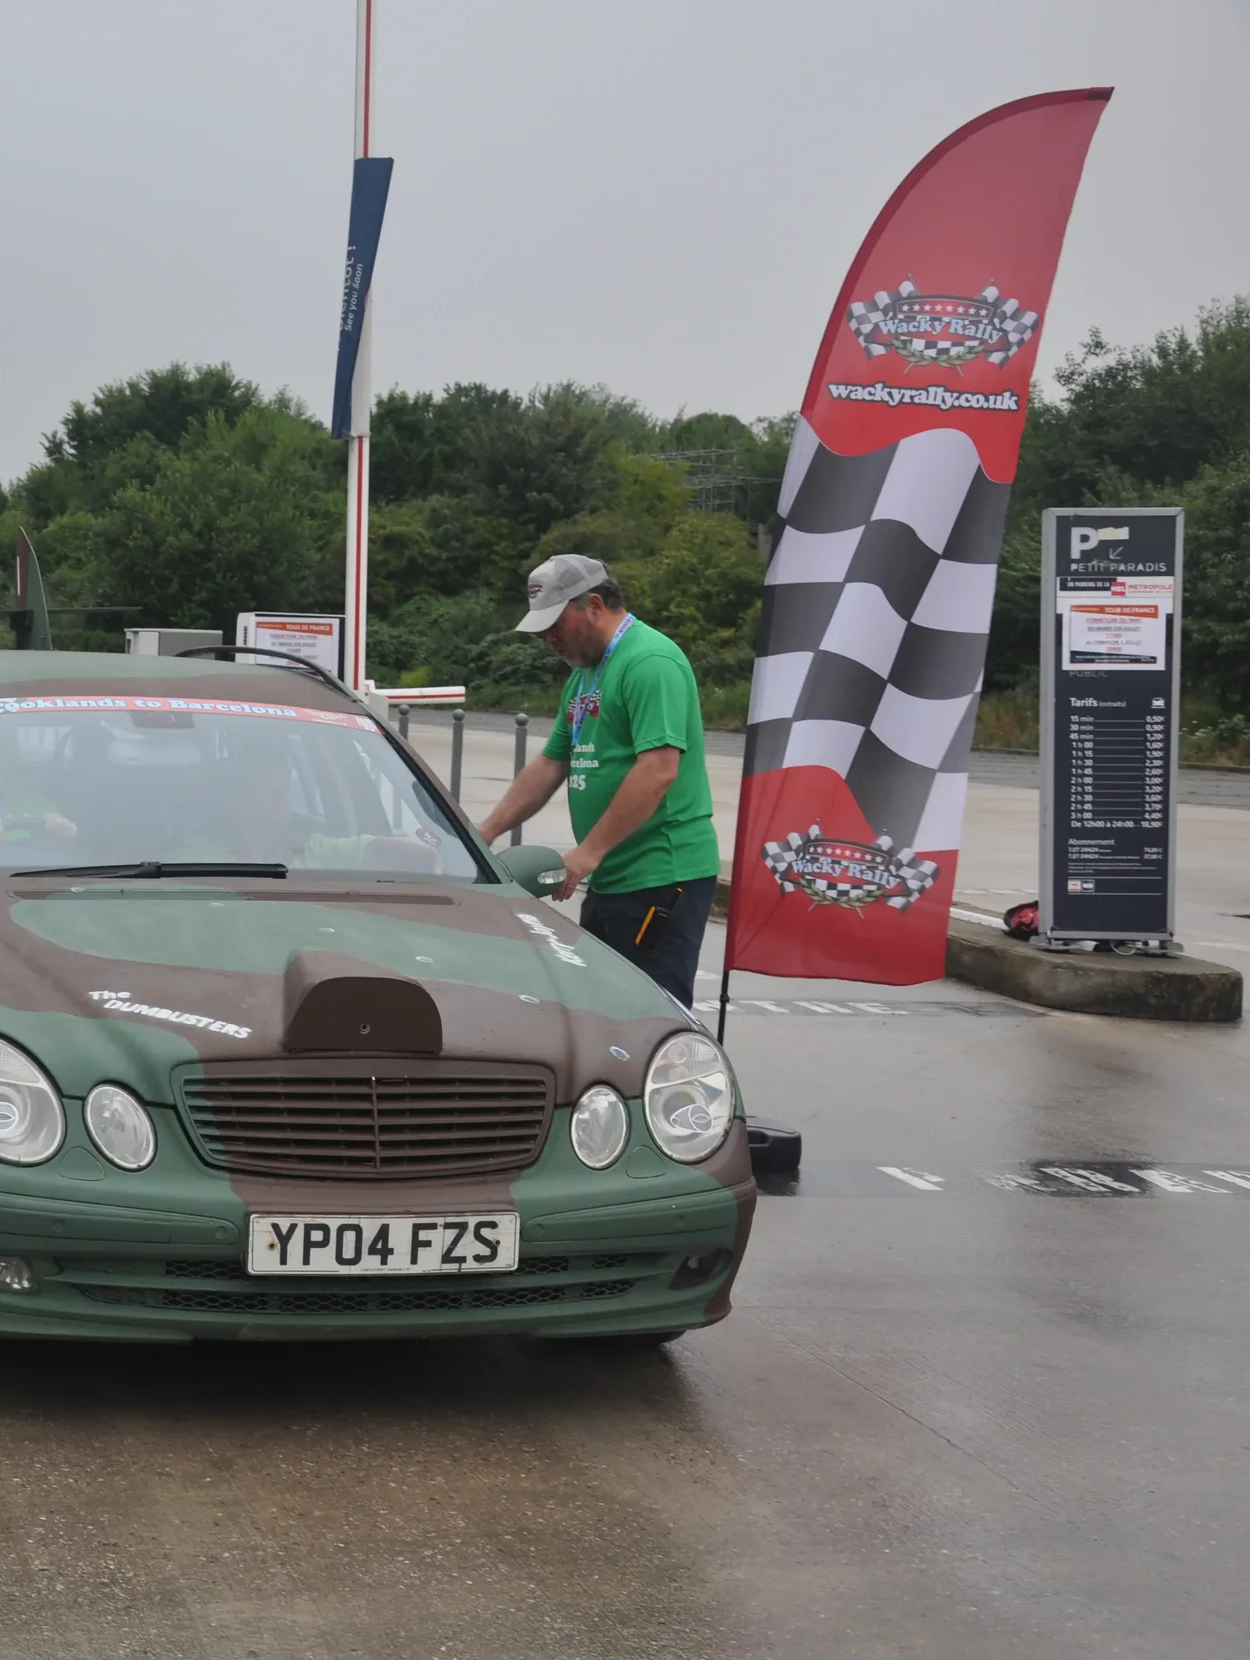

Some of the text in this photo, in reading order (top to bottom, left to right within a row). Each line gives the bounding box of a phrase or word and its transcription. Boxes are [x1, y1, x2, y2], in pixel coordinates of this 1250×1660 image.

[344, 263, 363, 331] See you soon
[877, 316, 1003, 344] Wacky Rally
[827, 383, 1019, 411] wackyrally.co.uk
[1070, 526, 1099, 559] P
[1070, 562, 1167, 572] PETIT PARADIS
[134, 698, 162, 708] to
[168, 699, 298, 718] Barcelona
[1069, 697, 1098, 707] Tarifs
[792, 859, 900, 889] Wacky Rally
[88, 990, 131, 1000] The
[103, 1000, 252, 1039] DUMBUSTERS
[270, 1220, 499, 1266] YP04 FZS
